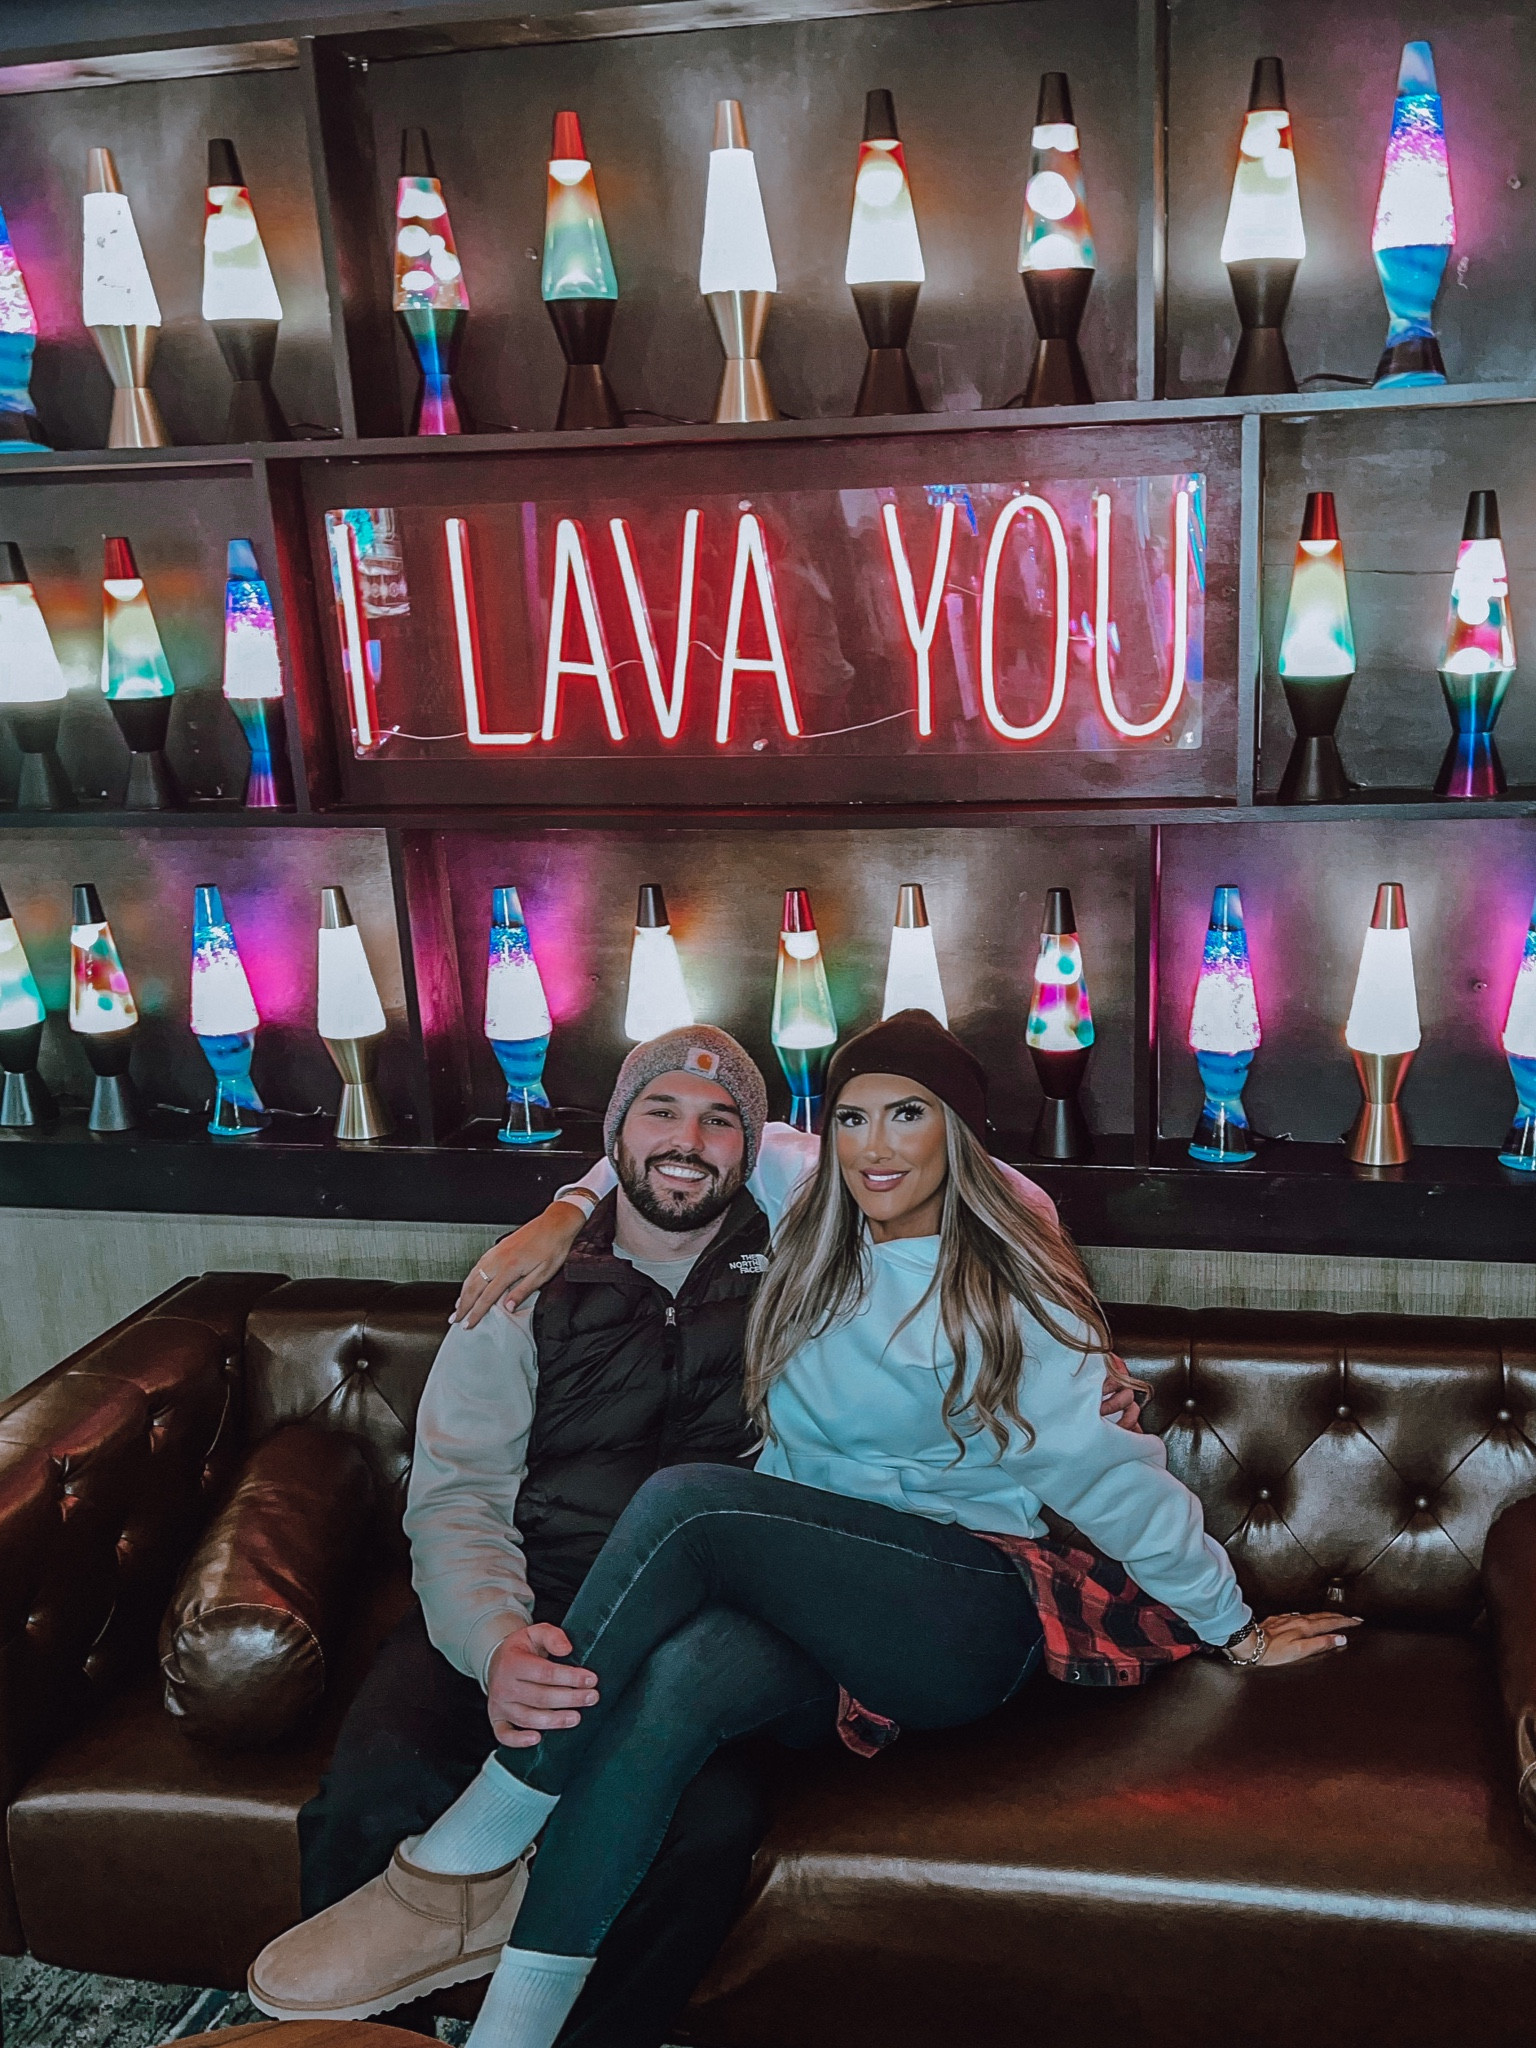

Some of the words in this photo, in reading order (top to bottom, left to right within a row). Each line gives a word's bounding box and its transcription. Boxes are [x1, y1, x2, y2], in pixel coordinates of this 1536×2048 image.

[333, 523, 373, 745] I
[446, 509, 801, 745] LAVA
[883, 490, 1190, 741] YOU
[728, 1259, 760, 1270] NORTH
